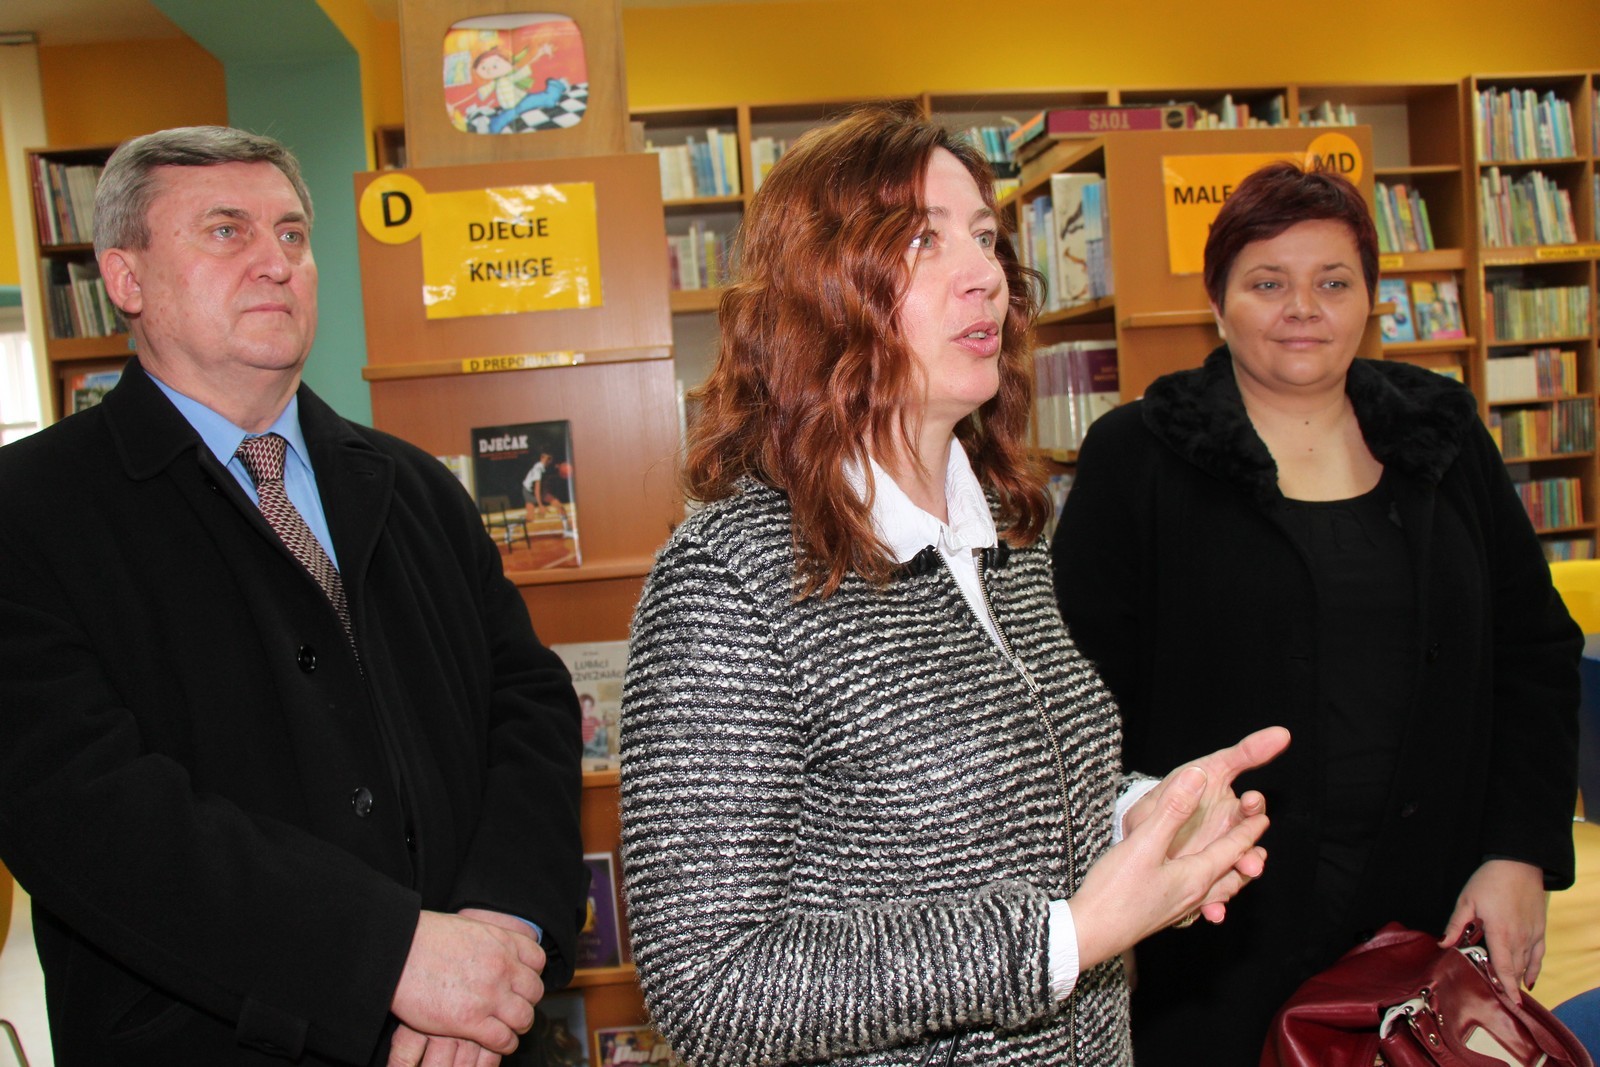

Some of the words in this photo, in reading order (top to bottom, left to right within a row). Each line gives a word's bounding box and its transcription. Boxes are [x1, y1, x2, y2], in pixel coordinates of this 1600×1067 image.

[1088, 112, 1130, 130] TOYS
[1313, 152, 1355, 173] MD
[1174, 185, 1232, 205] MALE
[381, 191, 412, 227] D
[469, 257, 553, 282] KNJIGE
[470, 360, 480, 372] D
